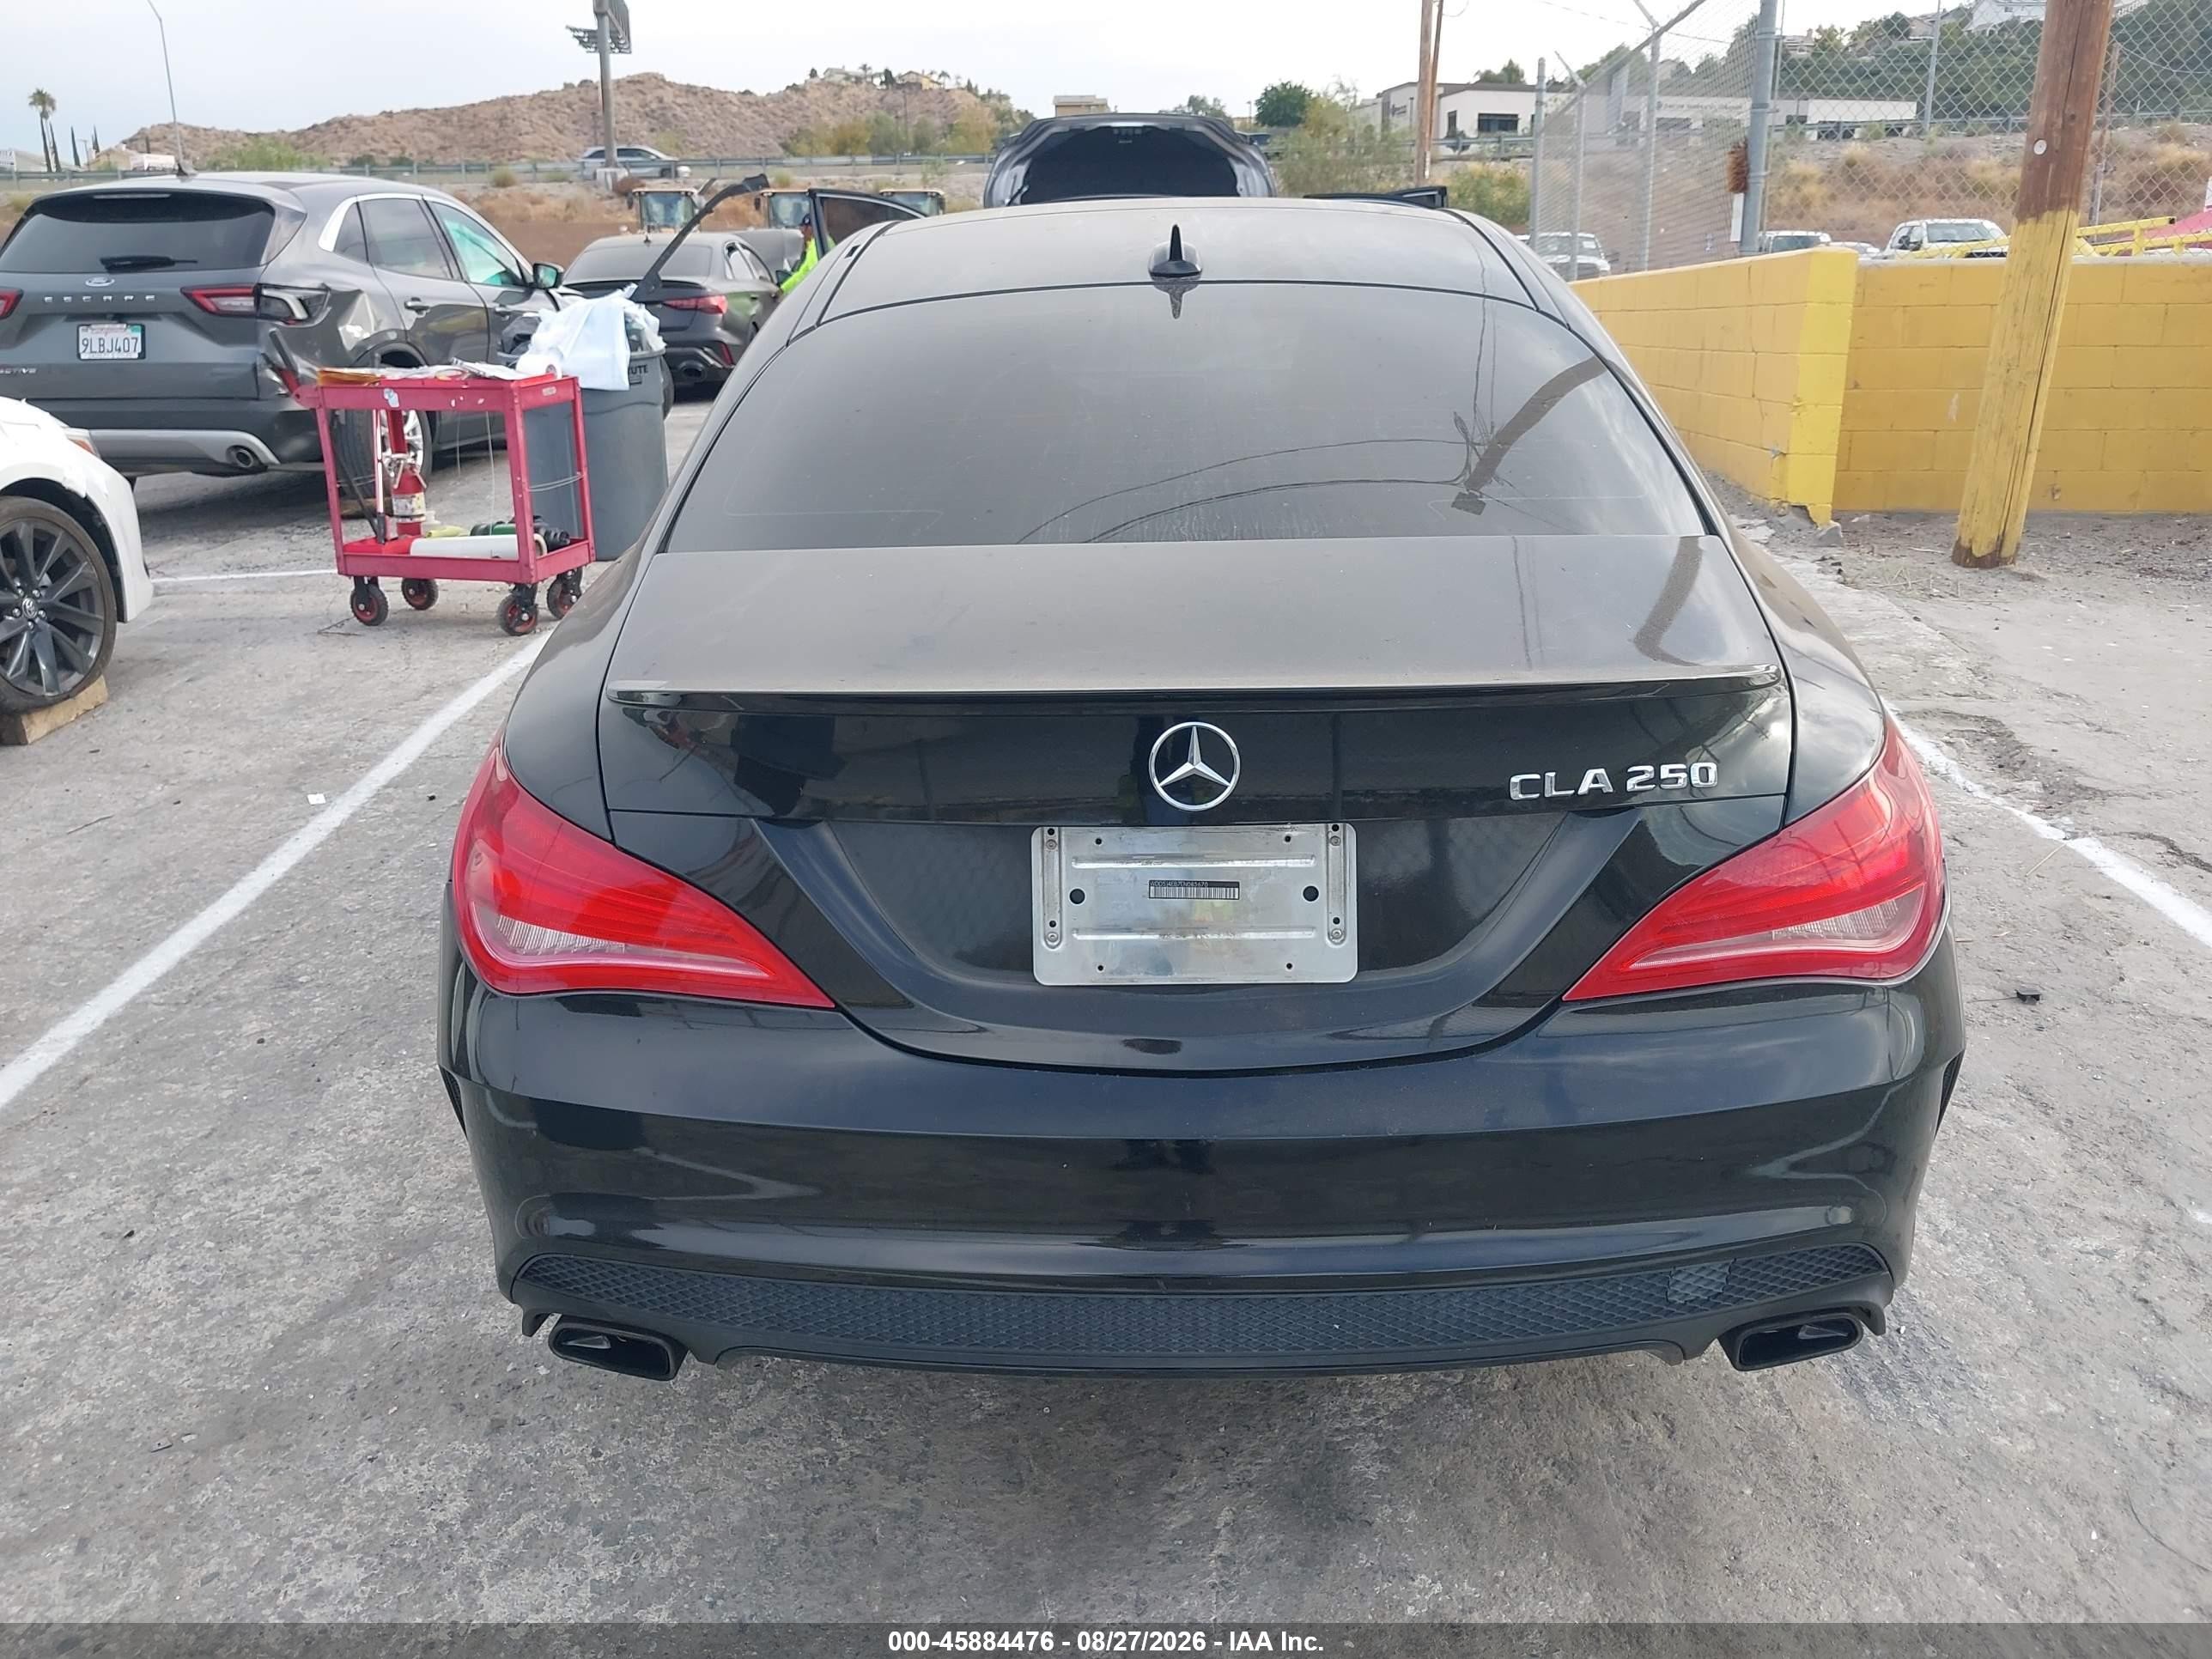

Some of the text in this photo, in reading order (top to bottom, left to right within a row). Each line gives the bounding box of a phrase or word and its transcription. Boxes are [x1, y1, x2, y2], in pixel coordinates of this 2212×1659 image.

[82, 337, 138, 354] 9LBJ407
[629, 364, 648, 374] UTE
[1510, 762, 1718, 800] CLA 250
